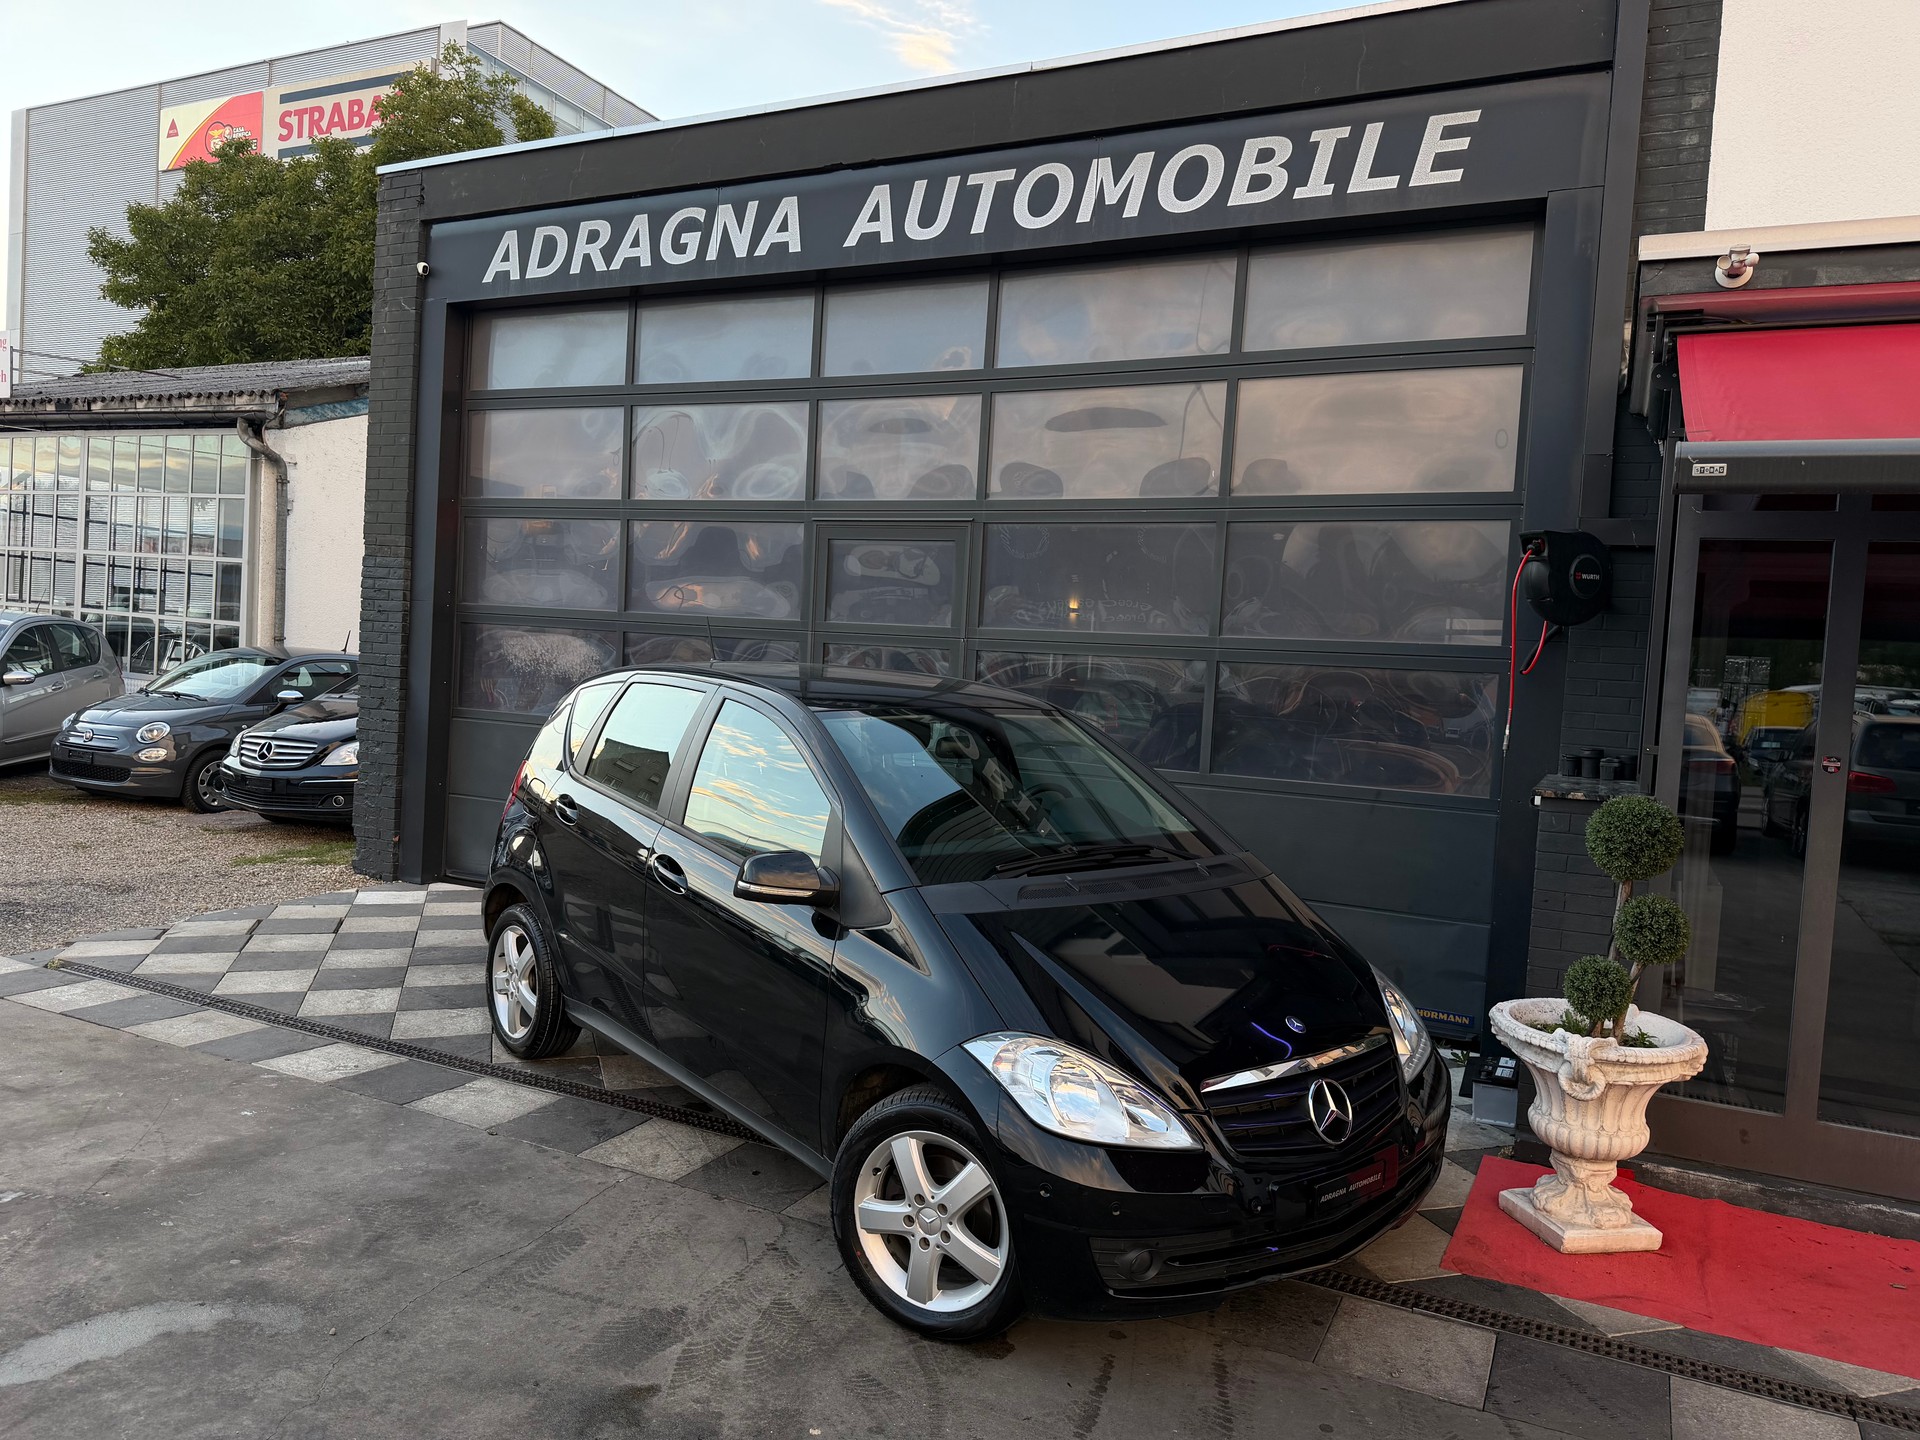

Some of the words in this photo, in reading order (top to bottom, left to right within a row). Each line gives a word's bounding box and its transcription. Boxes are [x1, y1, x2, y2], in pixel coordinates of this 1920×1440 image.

[481, 196, 802, 284] ADRAGNA
[842, 109, 1482, 248] AUTOMOBILE
[1320, 1187, 1347, 1203] ADRAGNA
[1348, 1172, 1382, 1192] AUTOMOBILE
